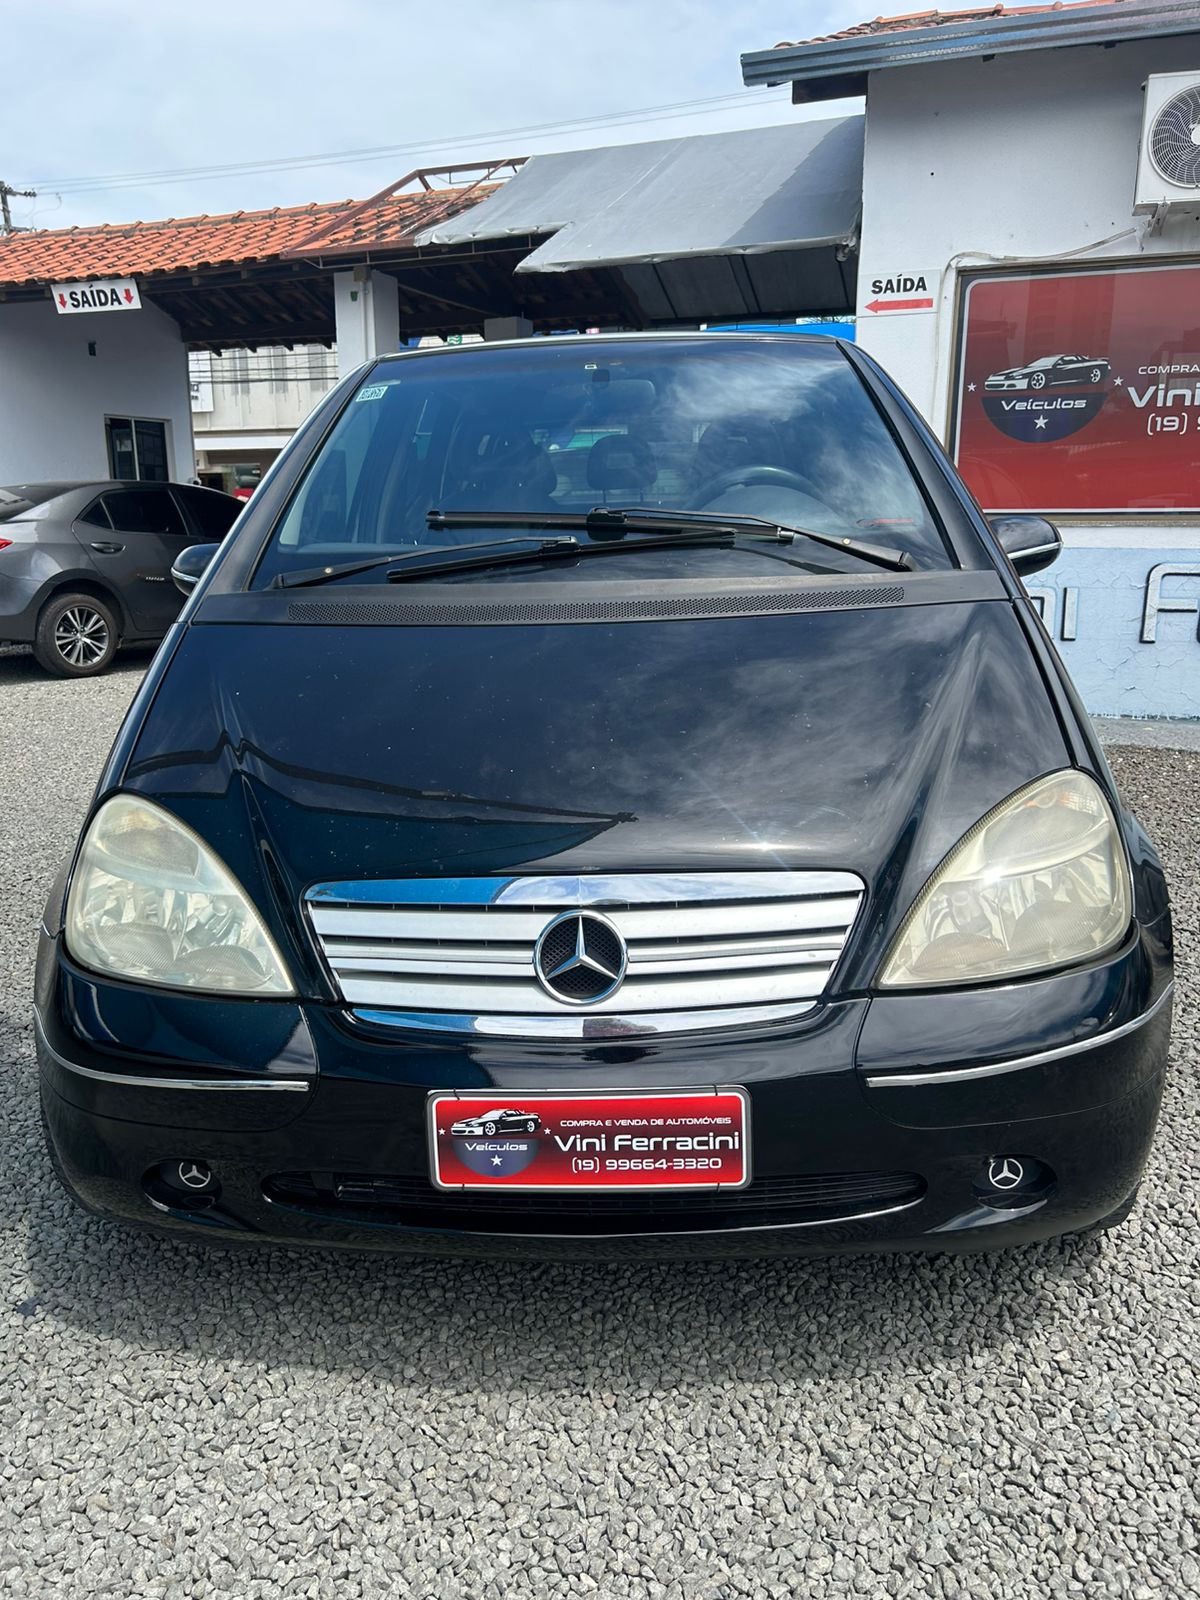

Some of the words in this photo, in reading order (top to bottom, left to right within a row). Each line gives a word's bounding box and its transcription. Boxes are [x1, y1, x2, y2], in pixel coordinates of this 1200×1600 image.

[871, 273, 928, 296] SAÍDA
[69, 284, 123, 309] SAÍDA
[1138, 364, 1200, 375] COMPRA
[1001, 397, 1088, 412] Veículos
[1127, 382, 1200, 408] Vini
[1147, 412, 1188, 436] (19)
[560, 1119, 603, 1128] COMPRA
[605, 1119, 613, 1127] E
[614, 1118, 649, 1127] VENDA
[650, 1118, 664, 1126] DE
[665, 1116, 732, 1126] AUTOMÓVEIS
[464, 1141, 528, 1152] Veículos
[554, 1133, 606, 1152] Vini
[614, 1131, 740, 1152] Ferracini
[572, 1156, 600, 1174] (19)
[605, 1157, 722, 1171] 99664-3320
